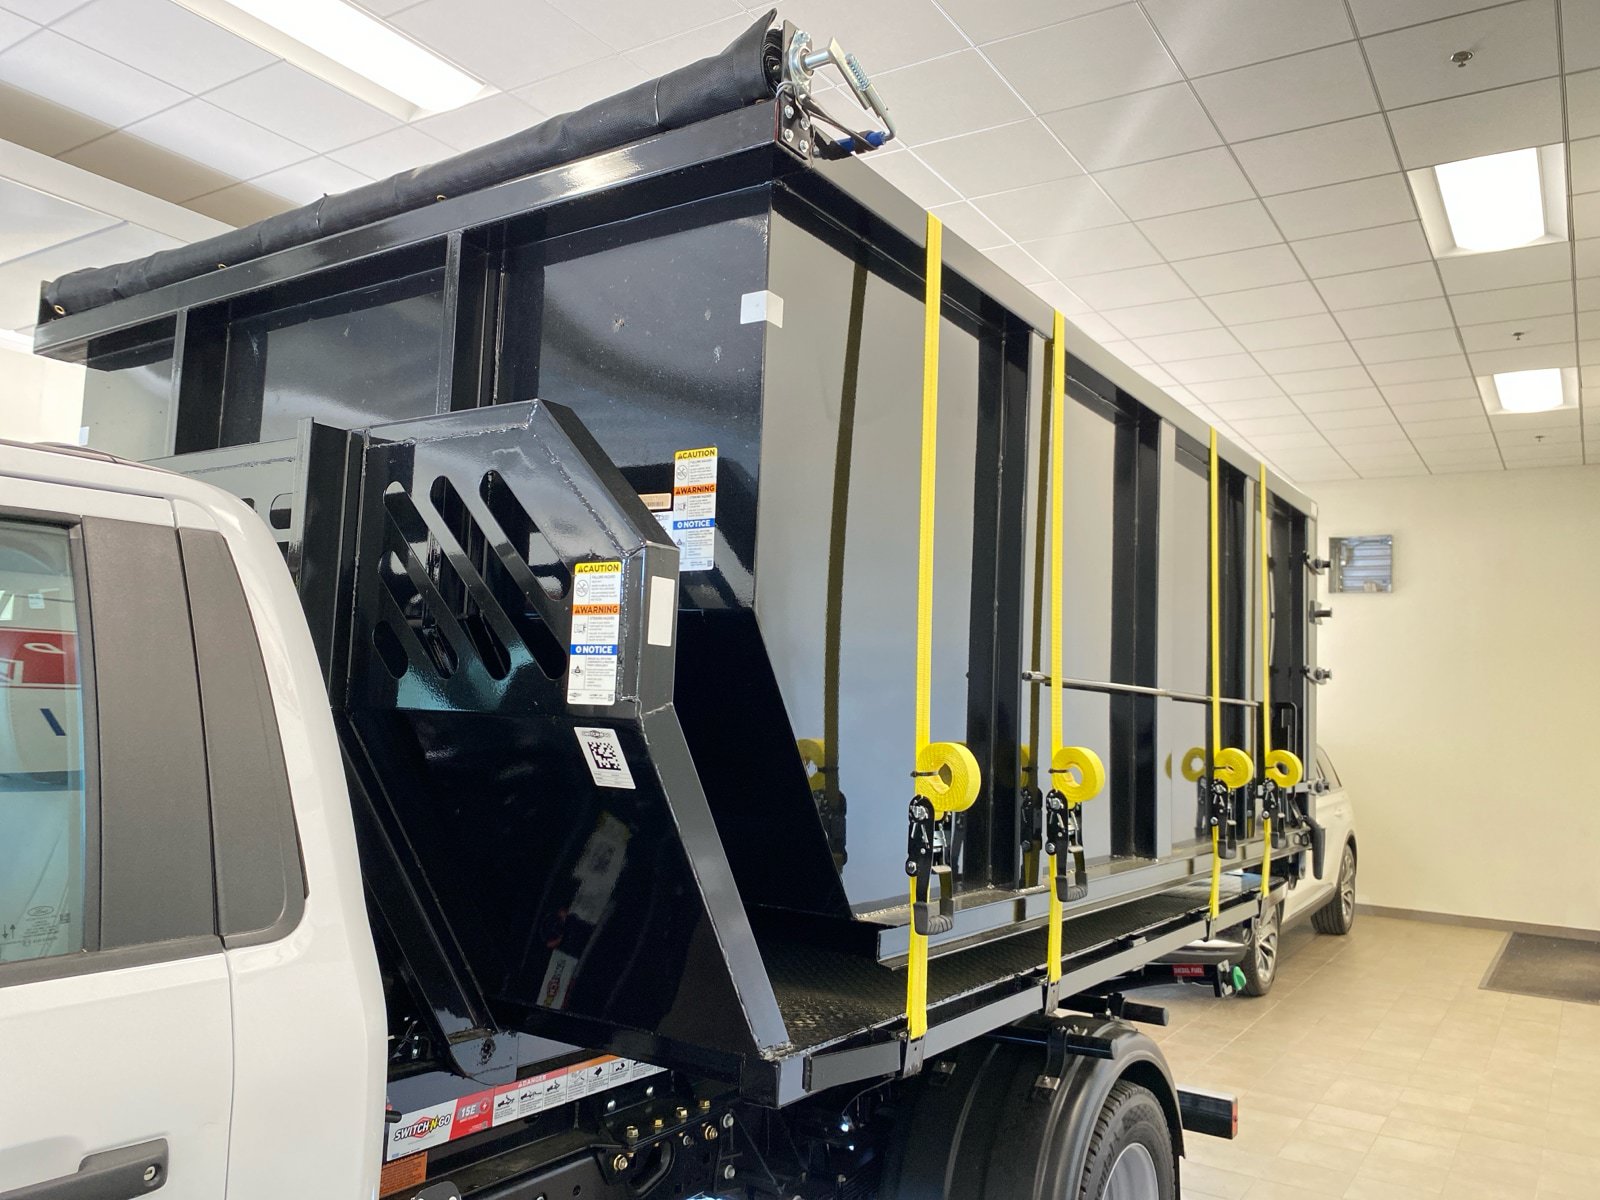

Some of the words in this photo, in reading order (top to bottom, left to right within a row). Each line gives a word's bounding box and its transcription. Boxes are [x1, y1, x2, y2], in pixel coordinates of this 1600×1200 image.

[682, 449, 716, 459] CAUTION
[681, 485, 715, 494] WARNING
[683, 519, 711, 528] NOTICE
[583, 563, 619, 573] CAUTION
[580, 605, 618, 614] WARNING
[582, 645, 613, 654] NOTICE
[461, 1103, 477, 1118] 15E
